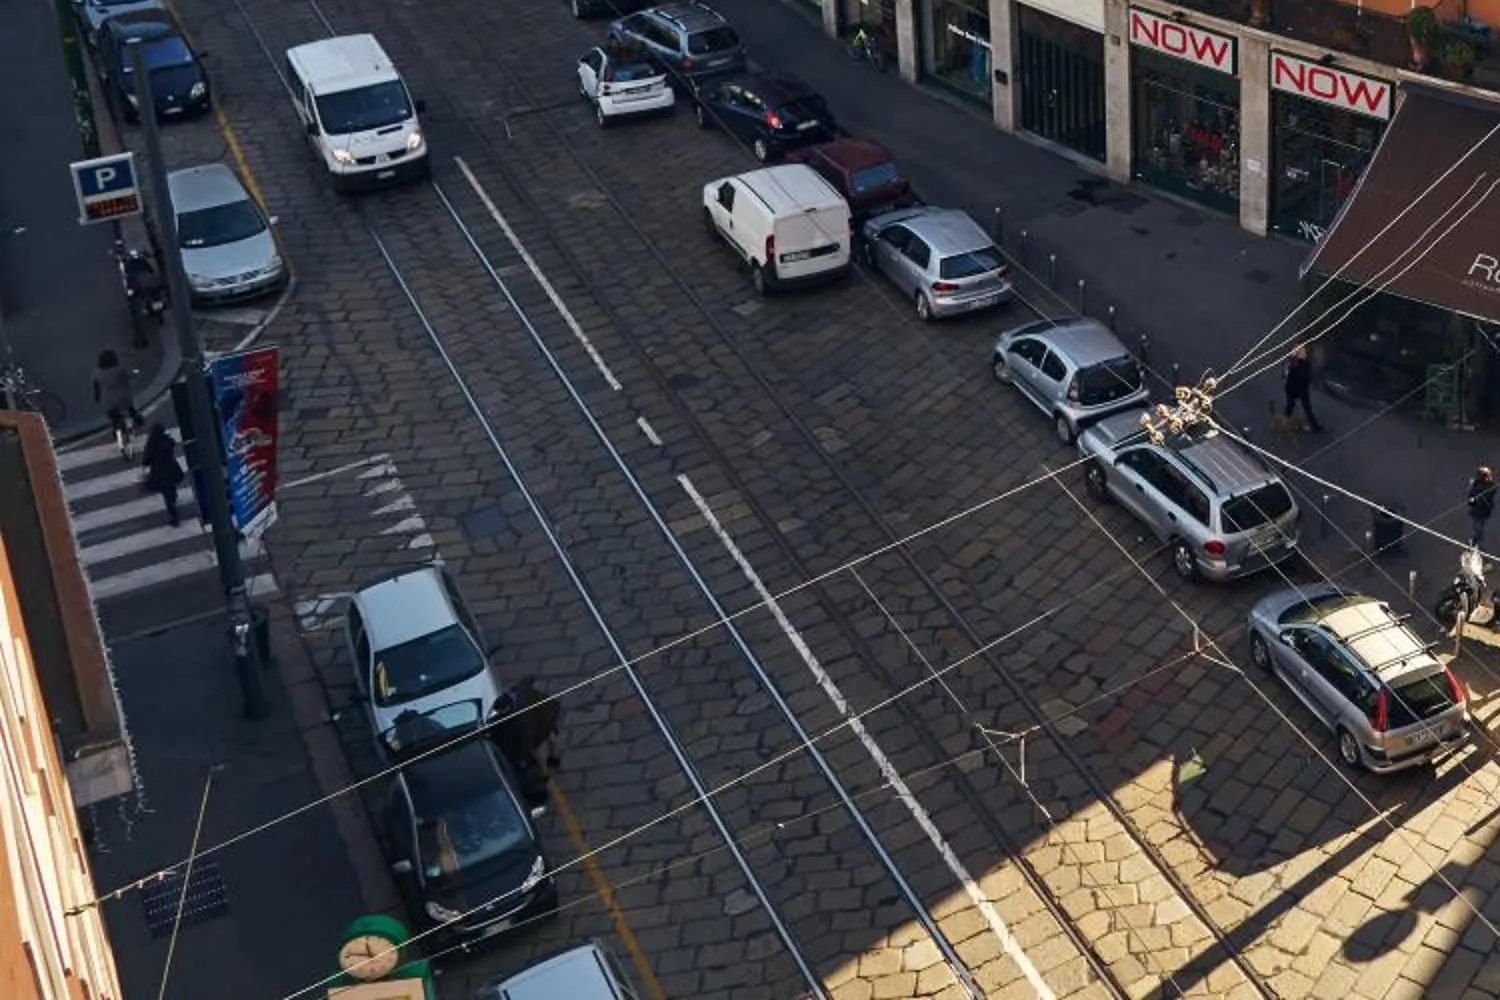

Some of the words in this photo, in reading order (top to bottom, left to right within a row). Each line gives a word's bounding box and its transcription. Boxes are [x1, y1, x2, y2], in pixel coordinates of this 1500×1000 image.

[1131, 12, 1228, 67] NOW
[1274, 56, 1386, 112] NOW
[96, 167, 116, 191] P
